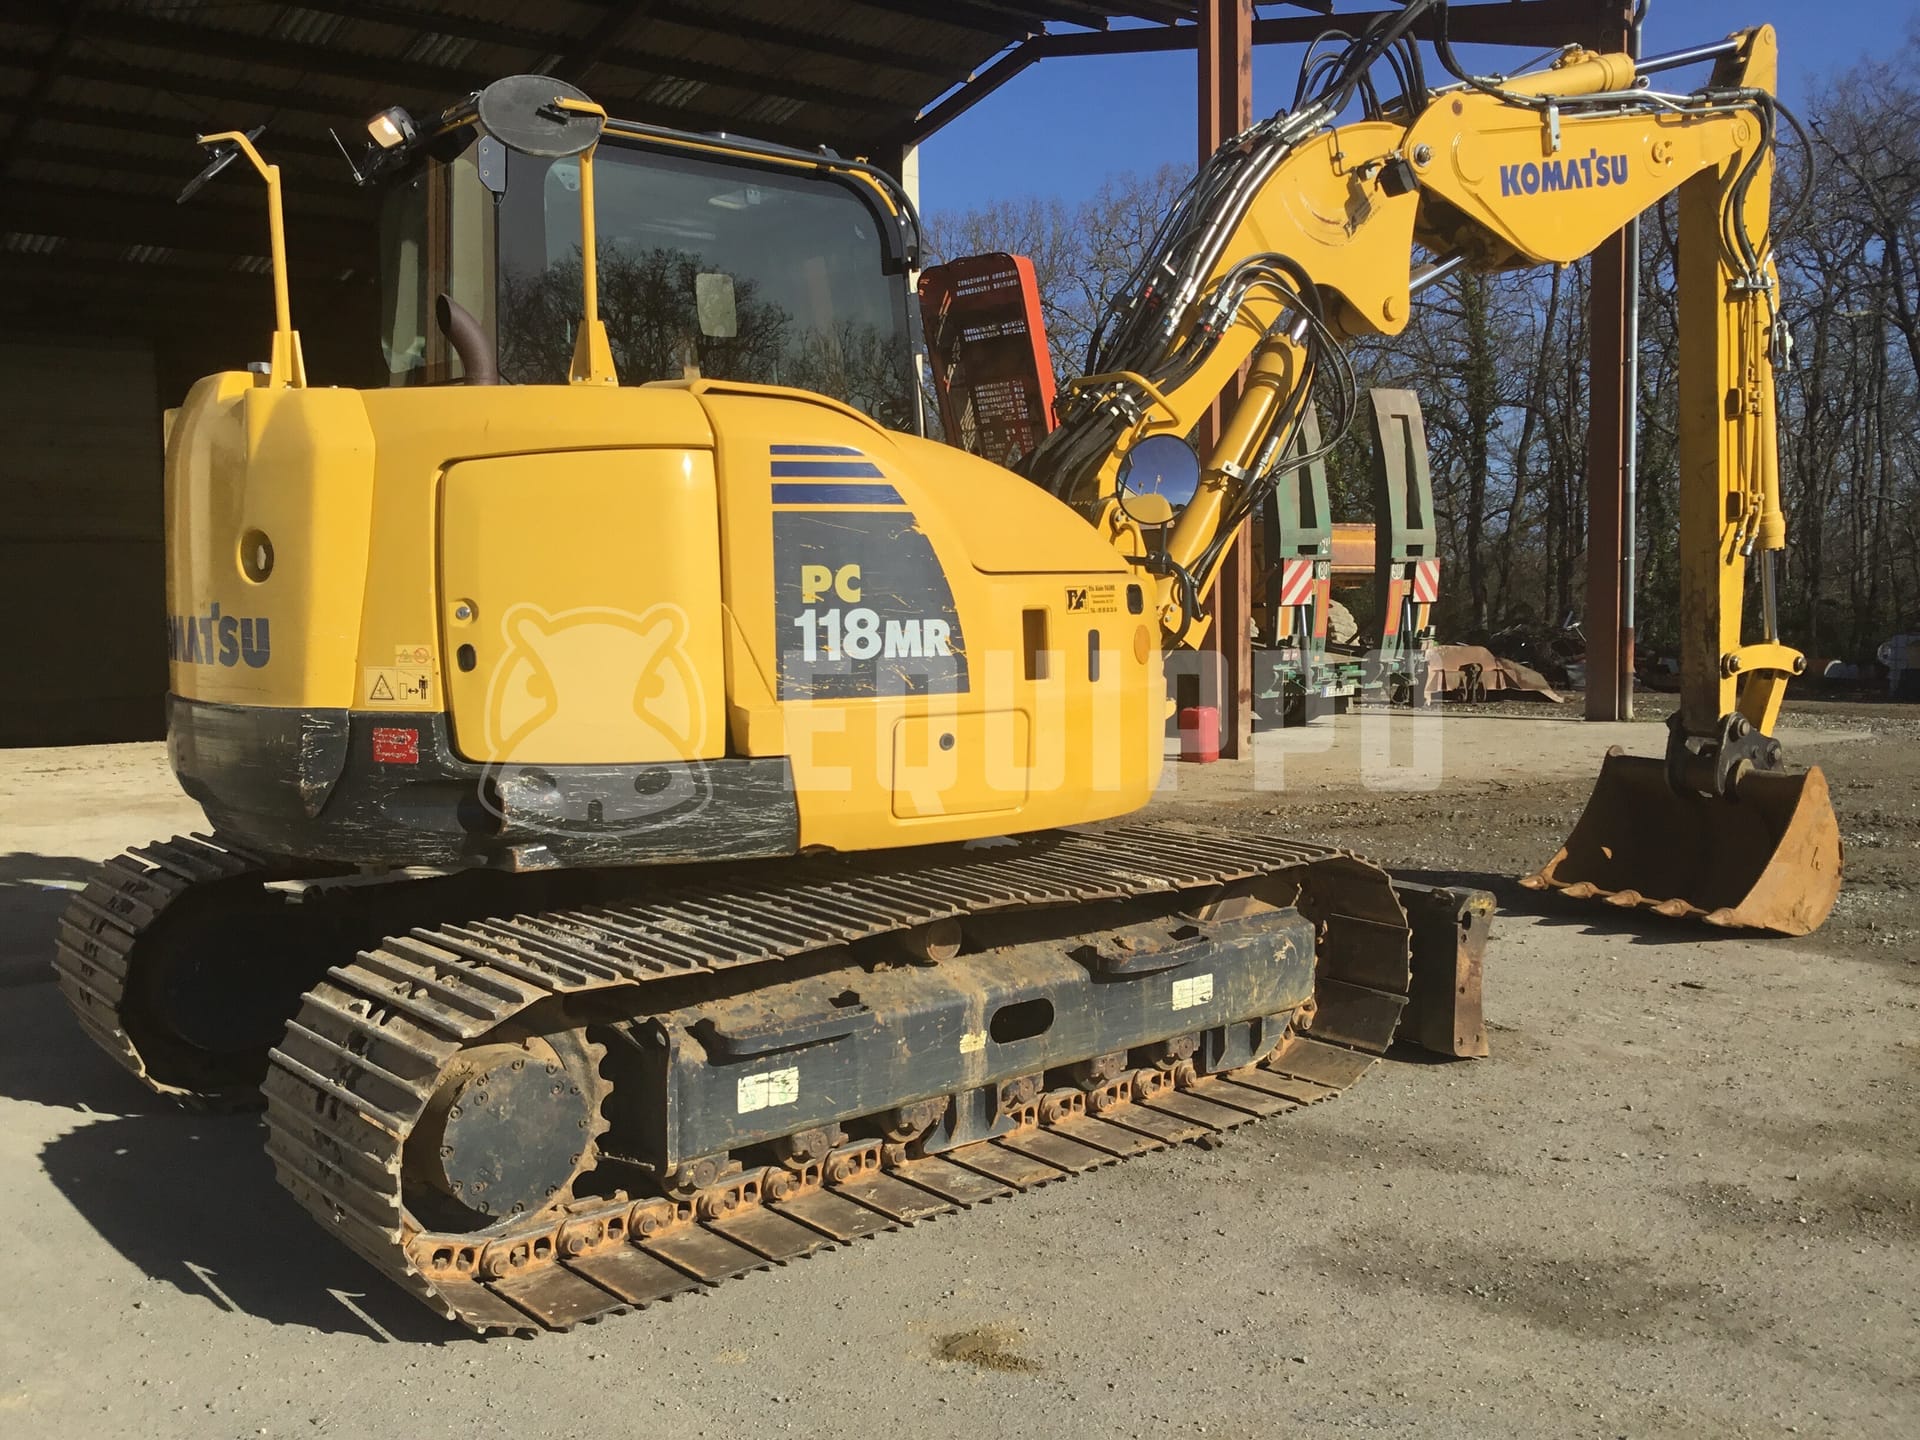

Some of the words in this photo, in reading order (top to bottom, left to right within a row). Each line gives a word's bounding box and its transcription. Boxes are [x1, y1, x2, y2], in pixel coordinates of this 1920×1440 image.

[1500, 148, 1629, 198] KOMATSU
[801, 563, 862, 604] PC
[167, 602, 271, 669] MATSU
[794, 607, 953, 662] 118MR
